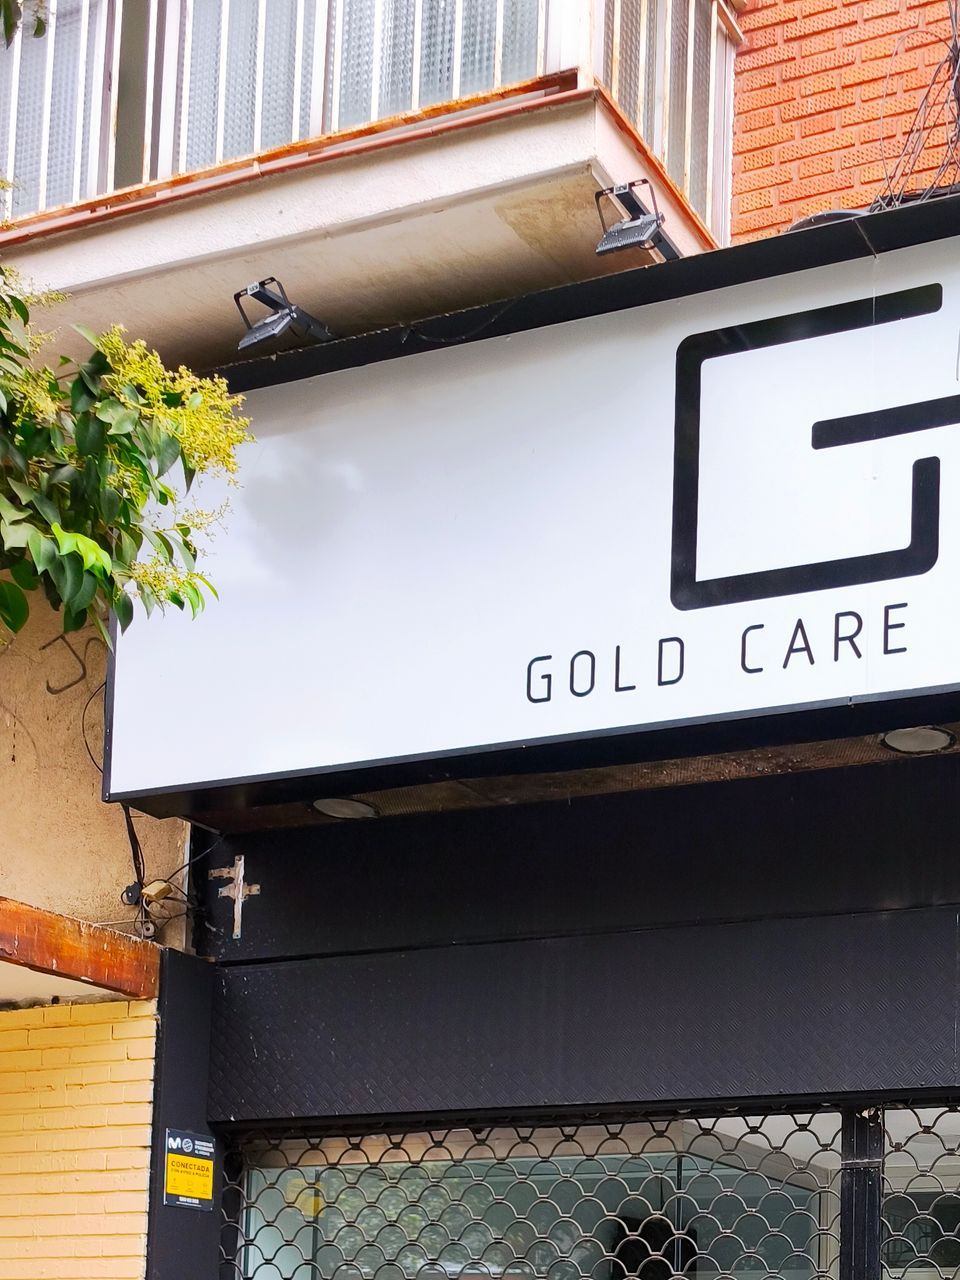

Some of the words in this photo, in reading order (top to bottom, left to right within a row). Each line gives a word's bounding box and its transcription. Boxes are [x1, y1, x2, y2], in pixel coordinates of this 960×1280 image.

[526, 636, 685, 704] GOLD
[740, 602, 908, 676] CARE
[171, 1160, 210, 1173] CONECTADA
